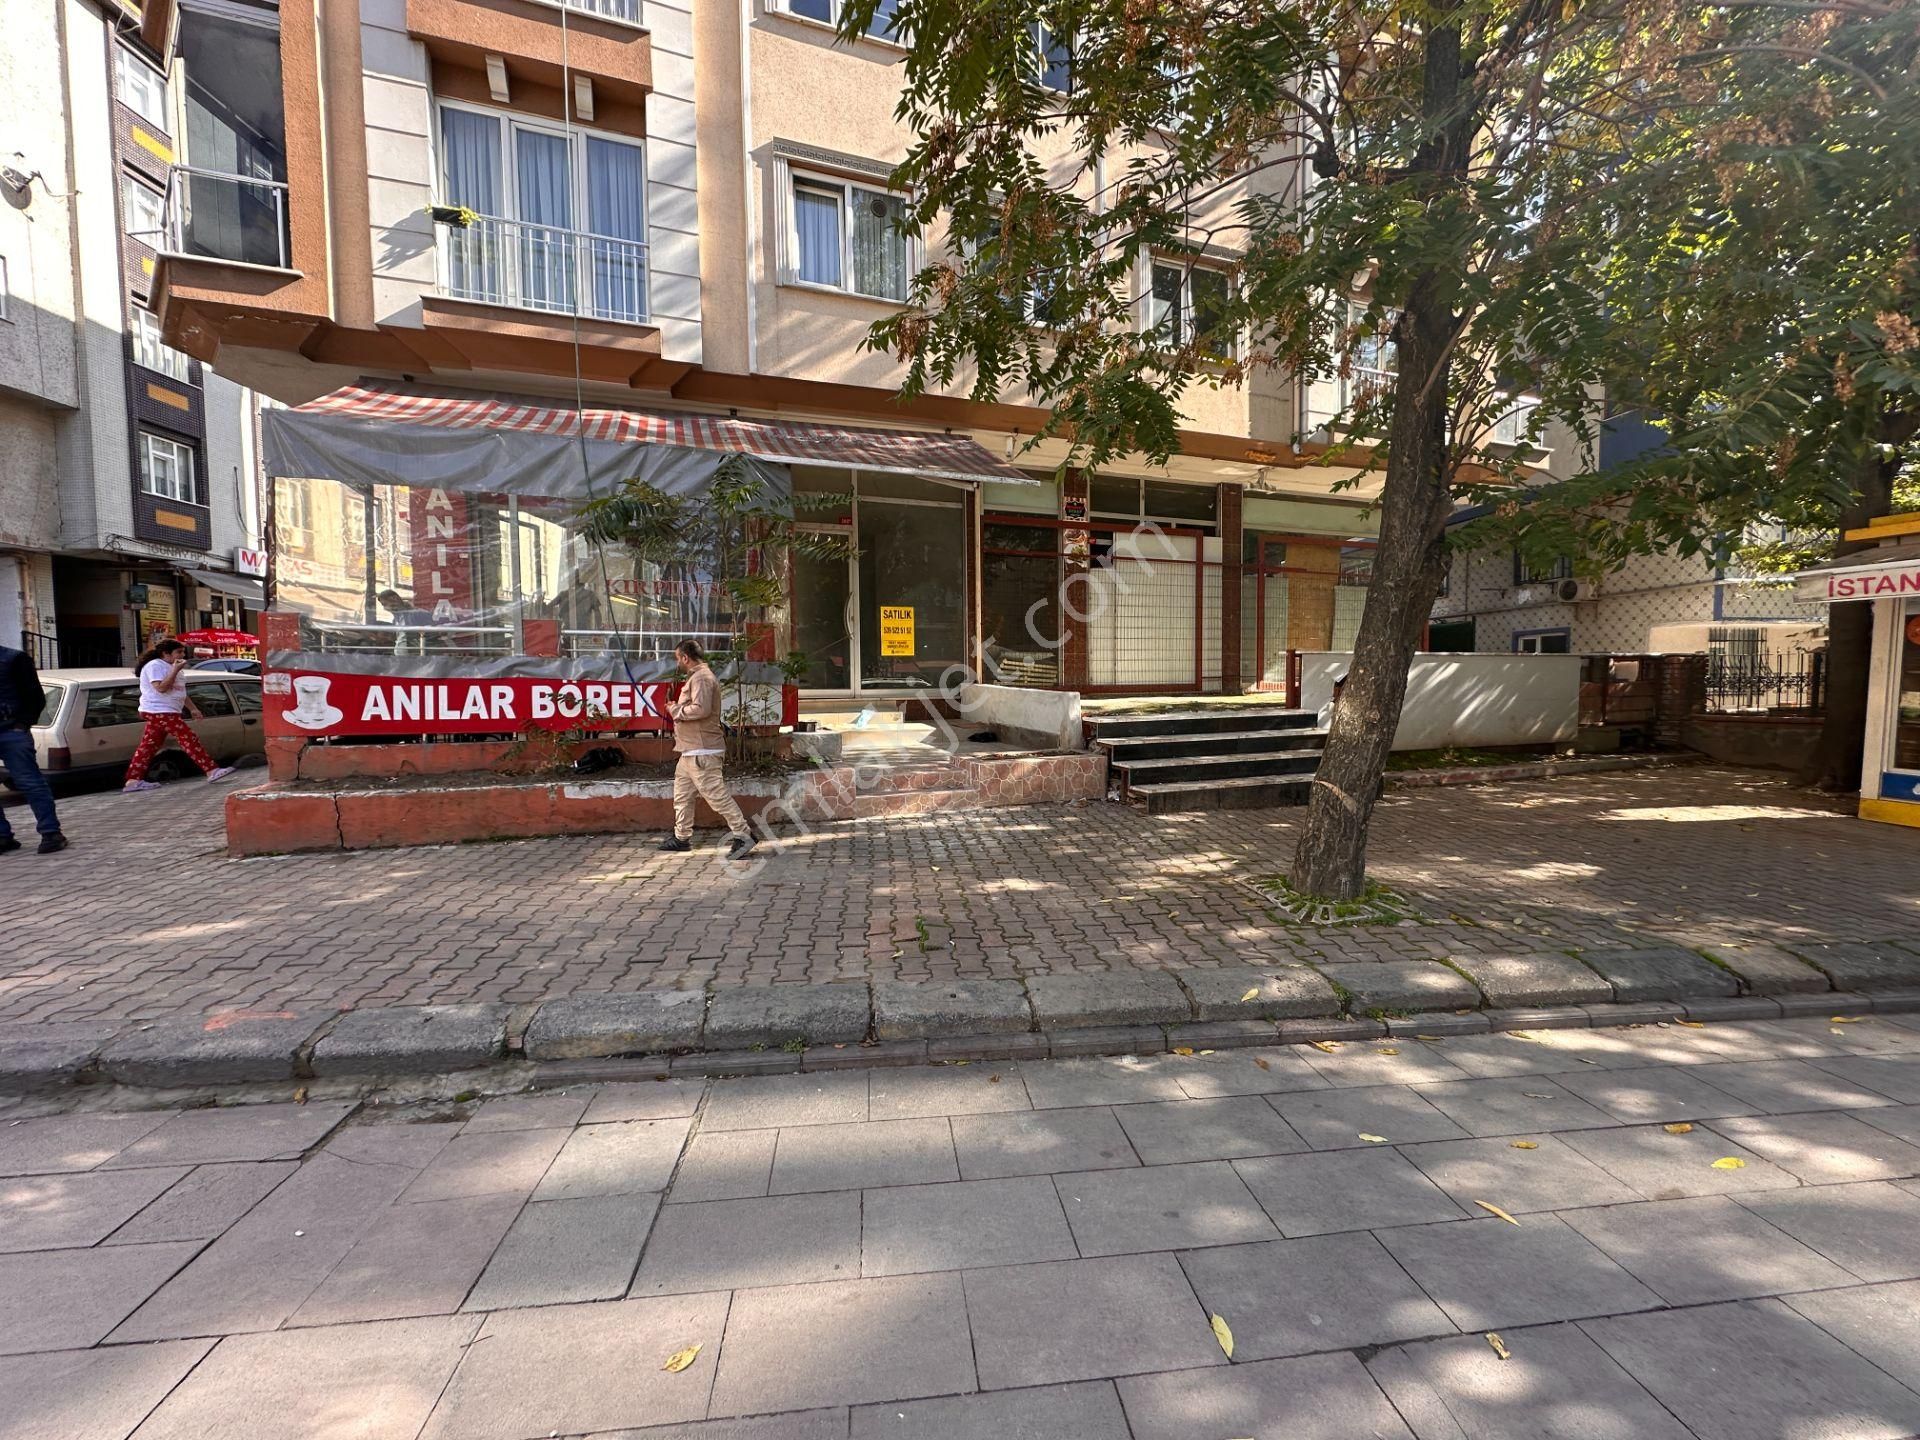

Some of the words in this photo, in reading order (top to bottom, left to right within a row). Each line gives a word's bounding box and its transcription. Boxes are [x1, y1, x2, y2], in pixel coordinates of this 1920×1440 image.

[883, 609, 912, 619] SATILIK
[361, 685, 516, 721] ANILAR
[531, 680, 658, 719] BÖREK
